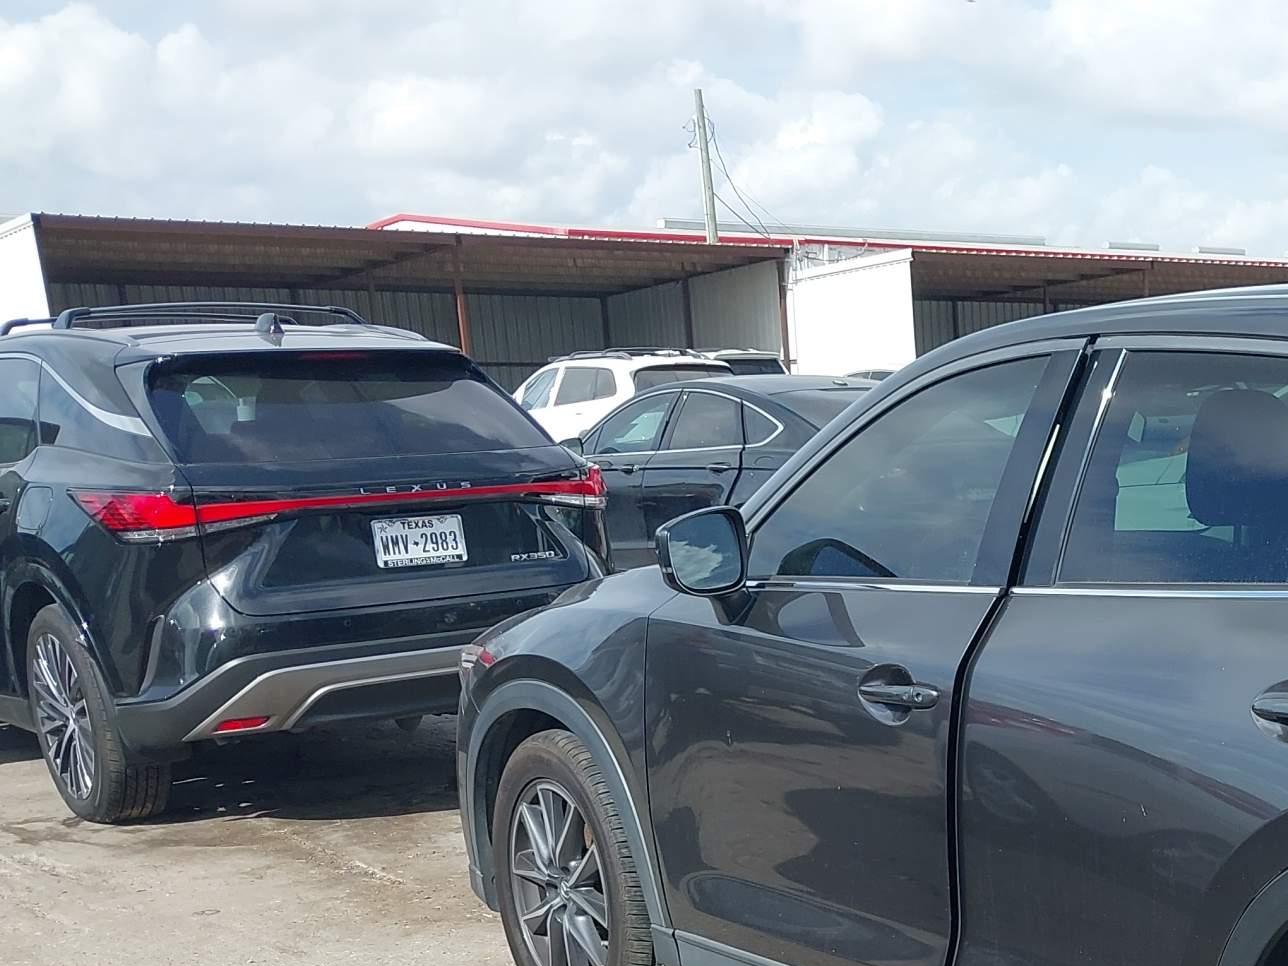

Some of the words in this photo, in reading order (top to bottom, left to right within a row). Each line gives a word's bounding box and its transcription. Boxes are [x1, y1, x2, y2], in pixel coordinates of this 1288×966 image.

[360, 481, 472, 494] LEXUS
[400, 520, 434, 530] TEXAS
[388, 557, 428, 568] STERLING
